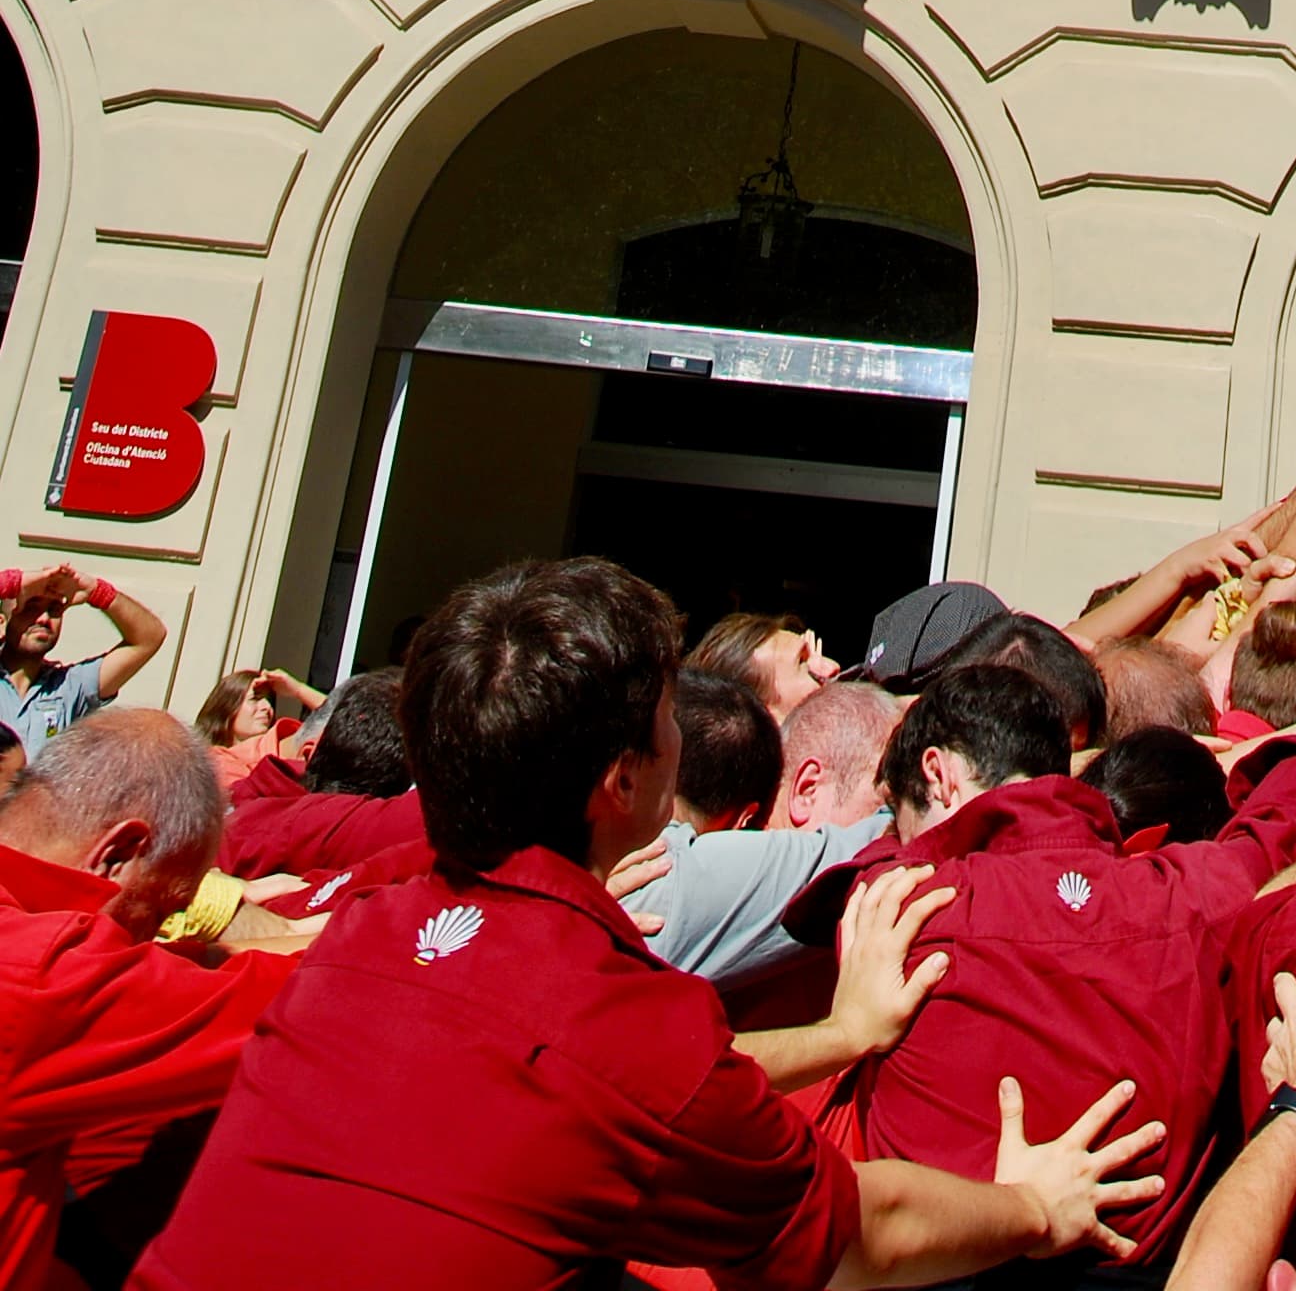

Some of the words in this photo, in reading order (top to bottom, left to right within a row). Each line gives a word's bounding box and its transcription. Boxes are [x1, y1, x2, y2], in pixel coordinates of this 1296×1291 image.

[91, 421, 110, 434] Seu
[111, 424, 128, 436] del
[129, 425, 169, 440] Districte
[86, 441, 120, 455] Oficina
[122, 445, 167, 460] d'Atenció
[83, 453, 132, 468] Ciutadana
